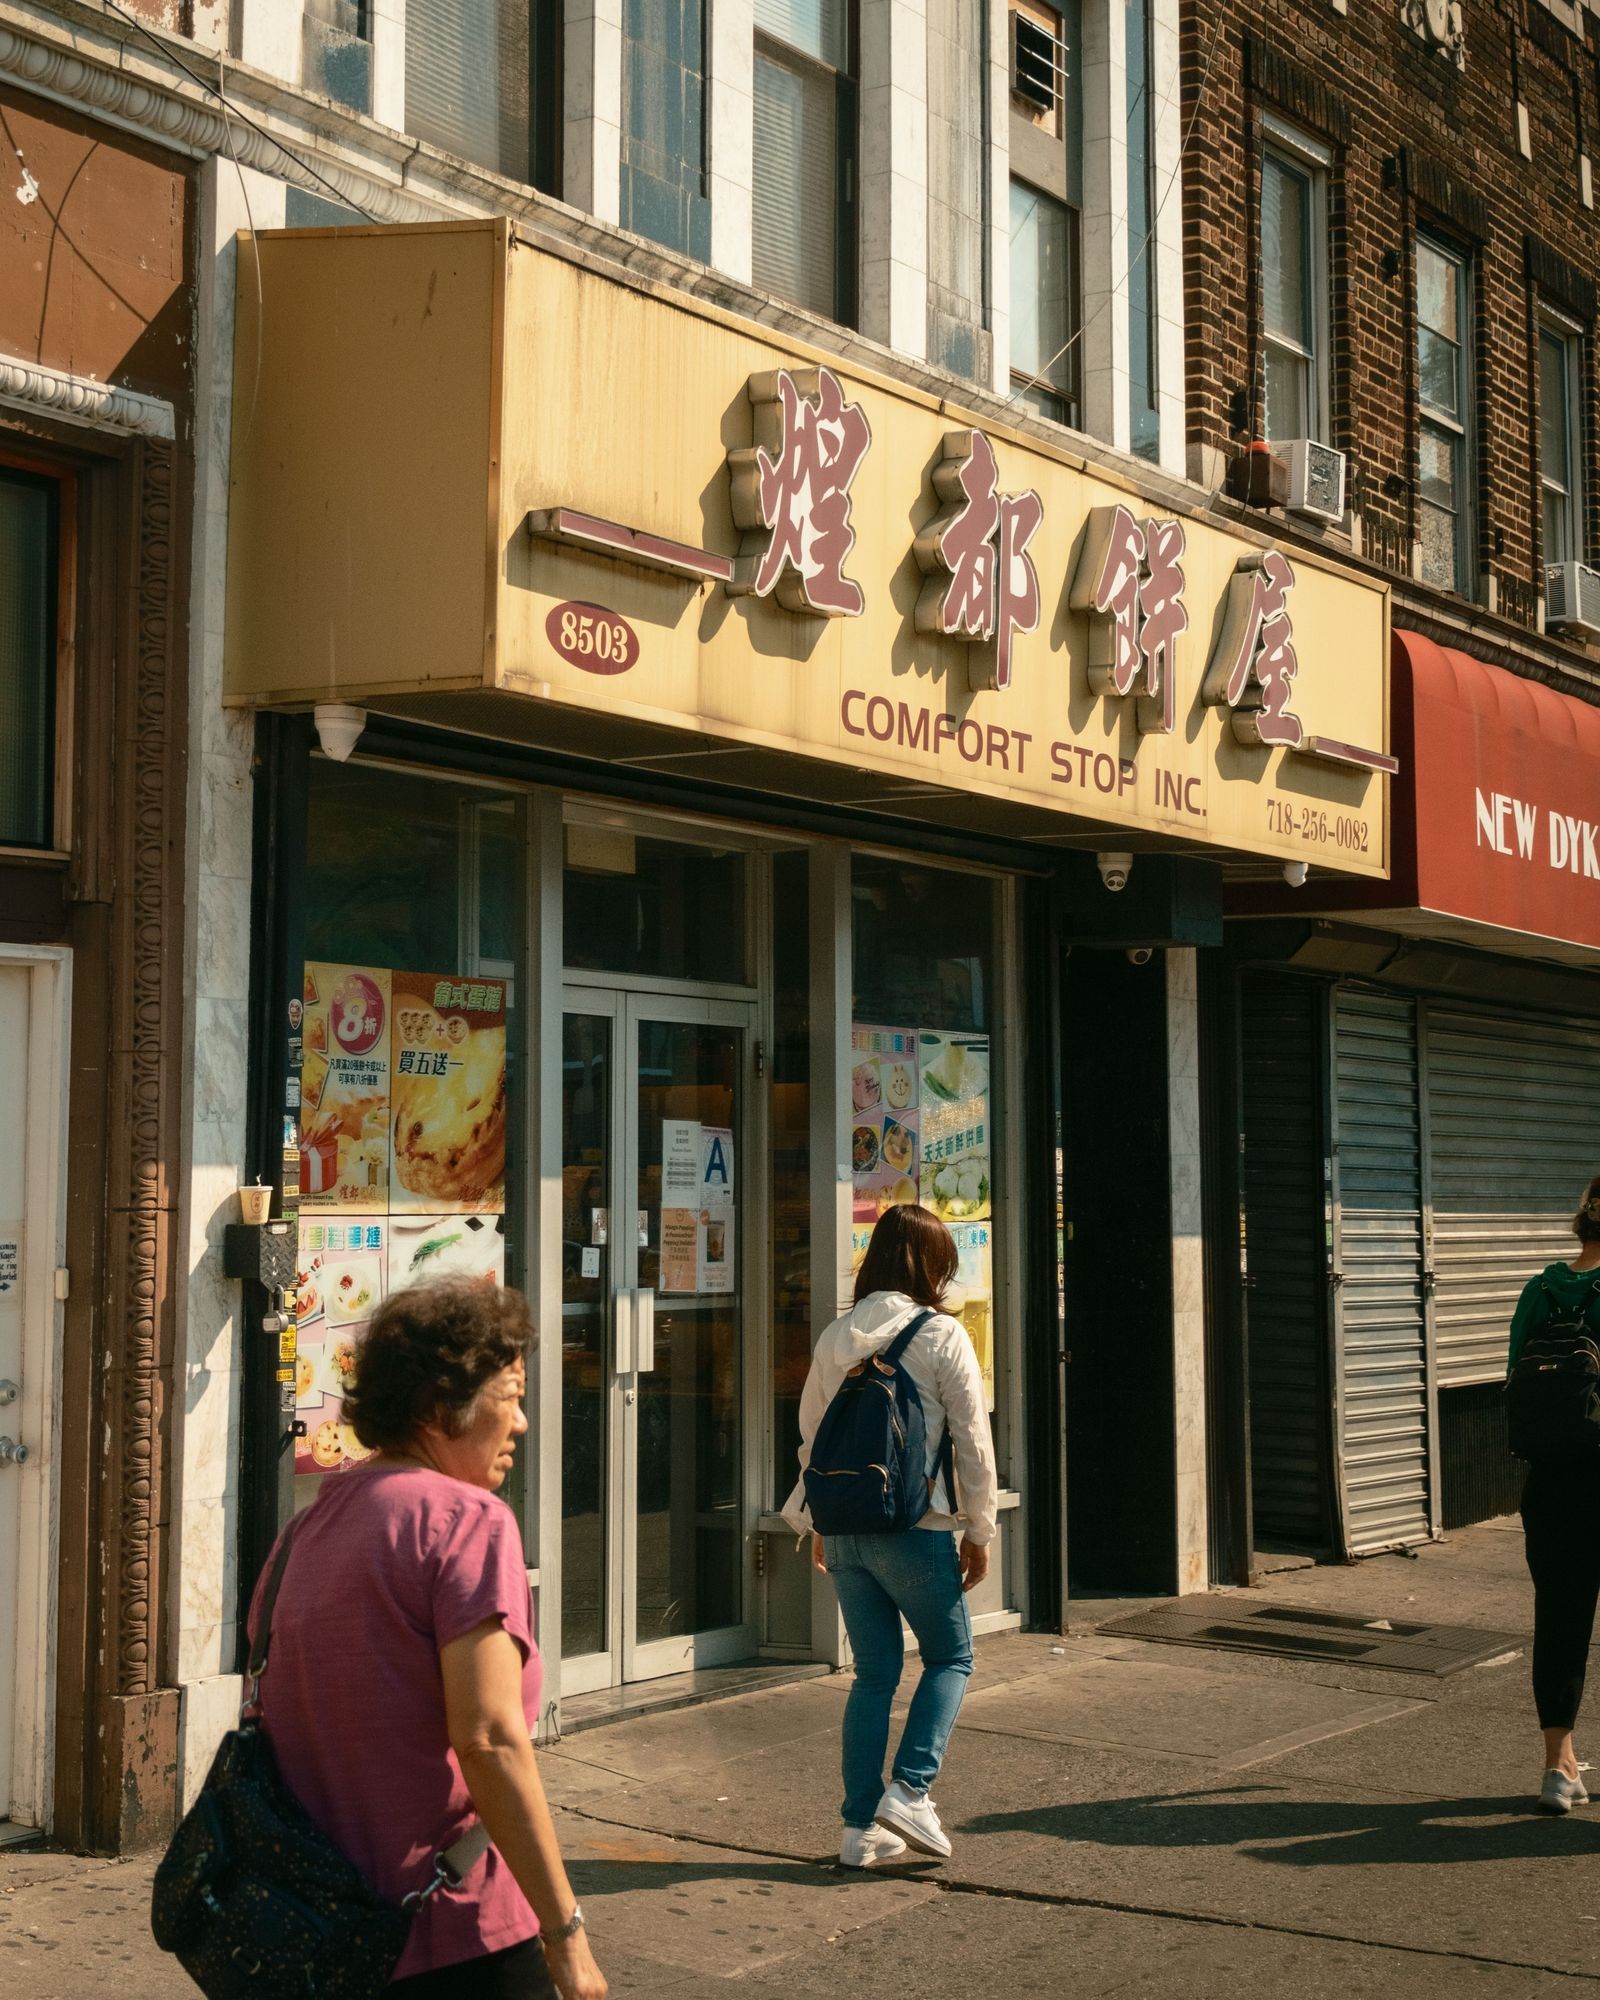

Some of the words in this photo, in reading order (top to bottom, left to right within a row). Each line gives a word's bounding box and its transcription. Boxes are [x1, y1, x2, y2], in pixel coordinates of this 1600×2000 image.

[753, 364, 1302, 749] 煌都餅屋
[559, 610, 629, 664] 8503
[841, 689, 1032, 775] COMFORT
[1050, 741, 1138, 798] STOP
[1154, 767, 1208, 817] INC.
[1265, 799, 1369, 853] 718-256-0082
[1475, 786, 1537, 861] NEW
[1549, 810, 1600, 881] DYK
[397, 1050, 465, 1076] 買五送一
[703, 1136, 729, 1184] A
[923, 1124, 985, 1163] 天天新鮮供應
